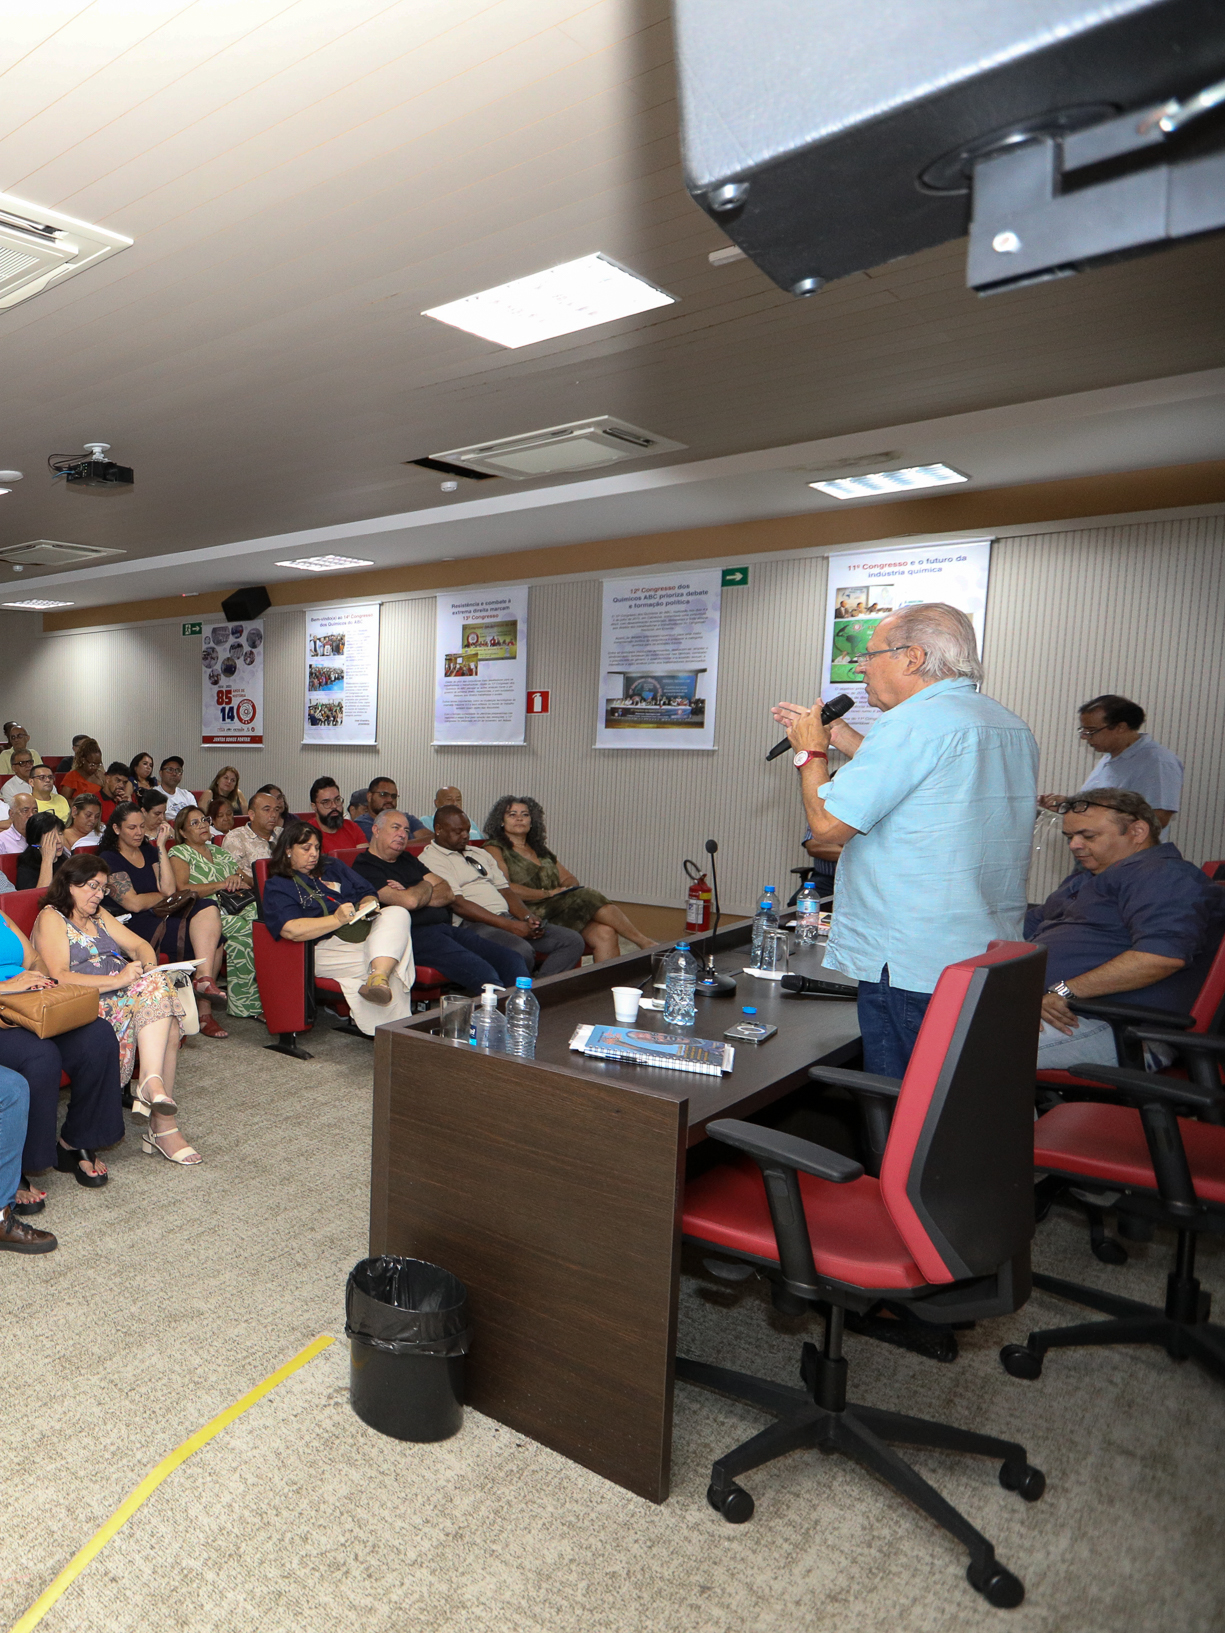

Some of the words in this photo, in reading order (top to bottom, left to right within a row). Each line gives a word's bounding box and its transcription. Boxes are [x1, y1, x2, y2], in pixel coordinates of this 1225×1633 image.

[862, 561, 908, 571] Congresso
[868, 569, 905, 578] indústria
[907, 567, 943, 575] química
[641, 586, 676, 594] Congresso
[216, 690, 232, 705] 85
[220, 706, 235, 722] 14
